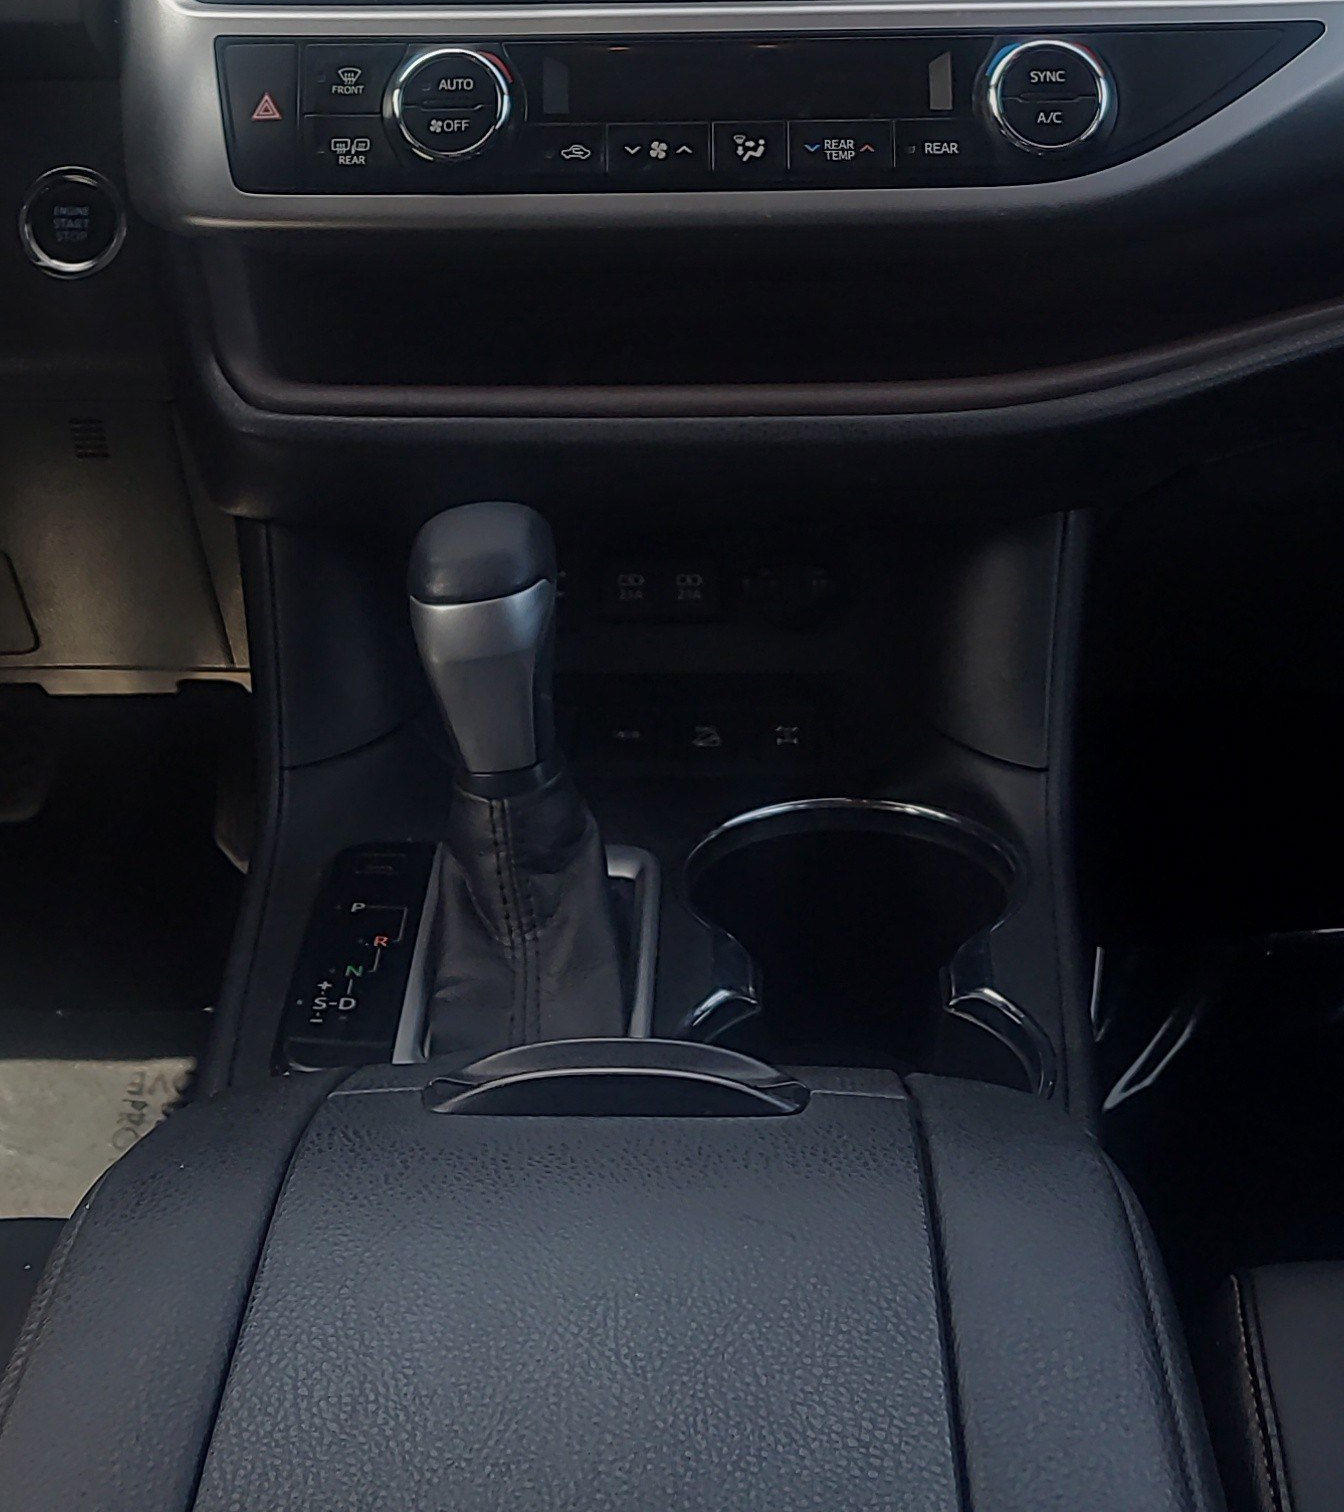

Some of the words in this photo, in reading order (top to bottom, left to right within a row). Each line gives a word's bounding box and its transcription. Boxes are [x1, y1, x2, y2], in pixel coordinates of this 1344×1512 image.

[1030, 70, 1066, 83] SYNC
[331, 84, 365, 95] FRONT
[438, 77, 474, 91] AUTO
[1036, 111, 1063, 125] A/C
[443, 119, 470, 132] OFF
[824, 139, 855, 152] REAR
[924, 142, 959, 155] REAR
[338, 155, 366, 166] REAR
[824, 150, 856, 161] TEMP
[350, 902, 366, 912] P
[373, 936, 389, 947] R
[344, 965, 363, 977] N
